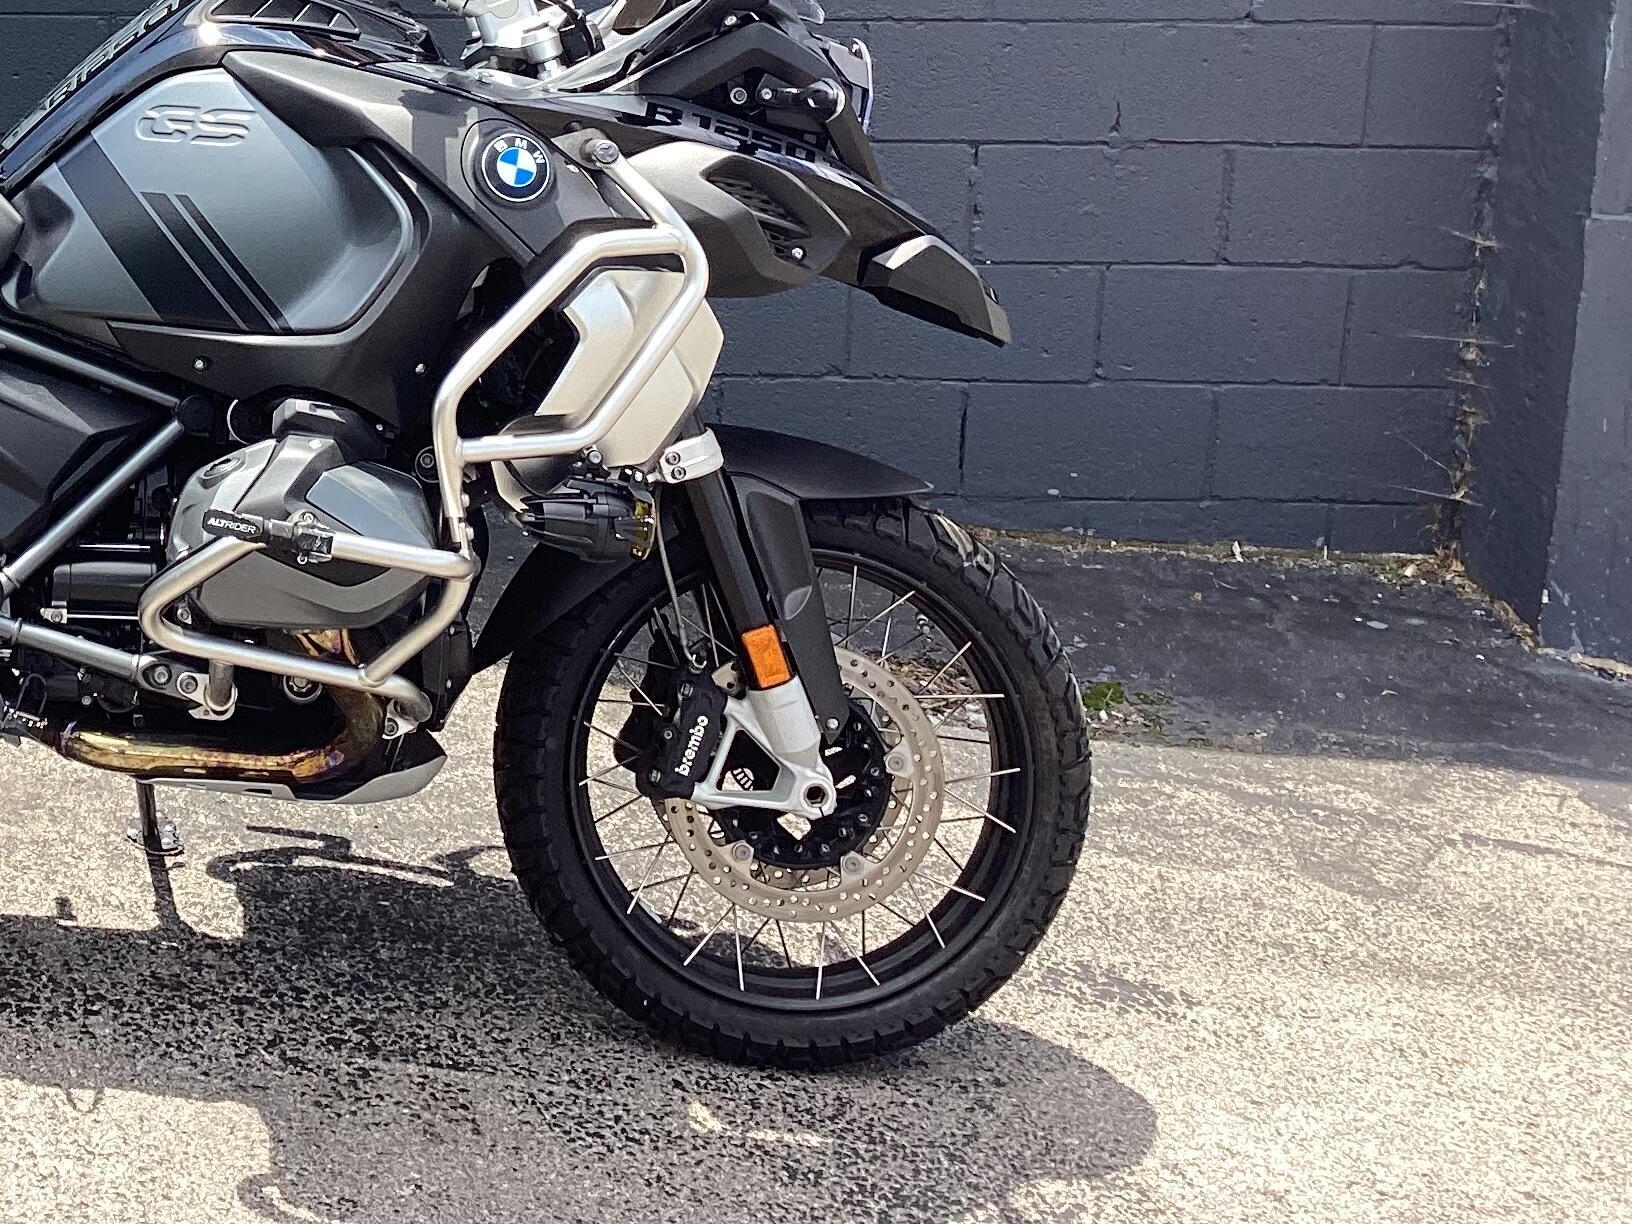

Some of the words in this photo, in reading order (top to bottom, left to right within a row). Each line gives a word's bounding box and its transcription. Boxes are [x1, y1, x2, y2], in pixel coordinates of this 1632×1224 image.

[135, 104, 257, 147] GS
[493, 136, 546, 165] BMW
[207, 517, 257, 534] ALTRIDER
[674, 715, 709, 777] brembo
